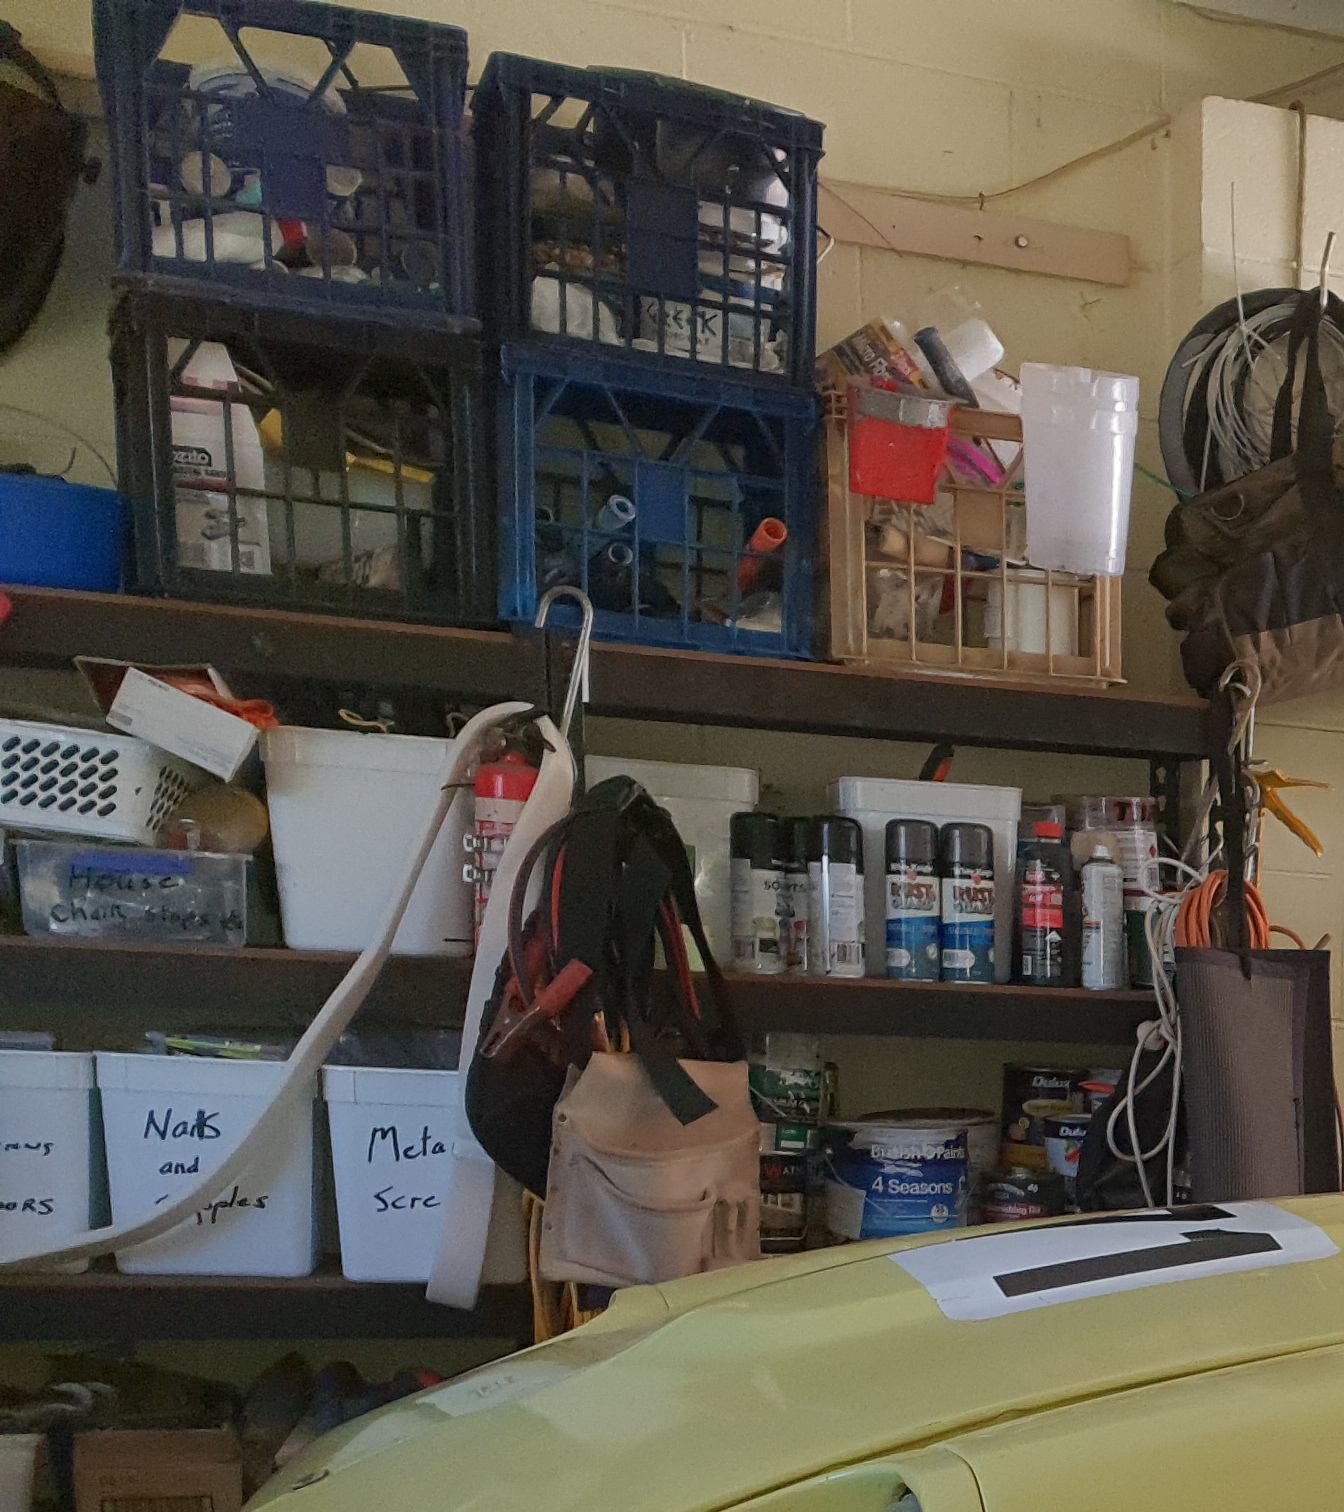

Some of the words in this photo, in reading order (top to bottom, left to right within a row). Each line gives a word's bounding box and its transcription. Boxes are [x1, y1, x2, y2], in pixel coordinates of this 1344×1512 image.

[367, 1124, 455, 1164] Meta
[158, 1155, 199, 1175] and
[871, 1175, 884, 1193] 4
[887, 1178, 953, 1195] Seasons
[373, 1185, 441, 1213] Scre
